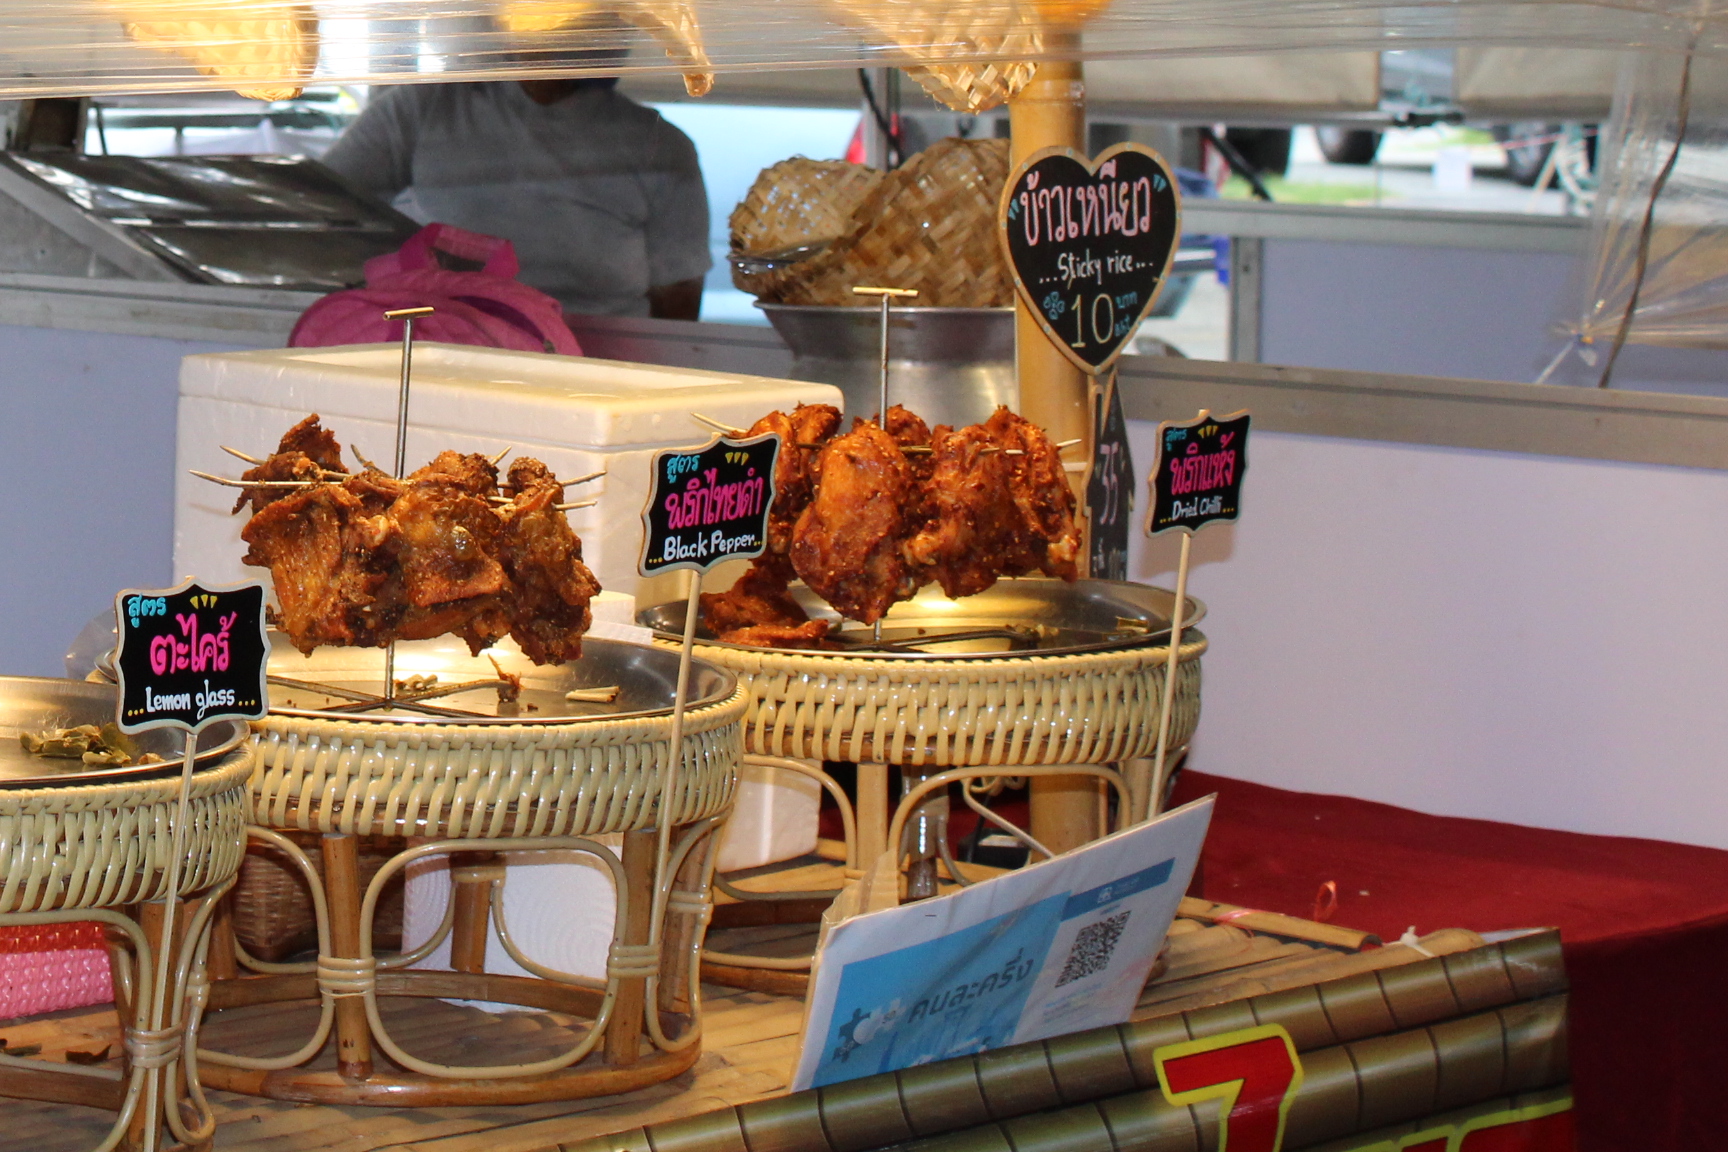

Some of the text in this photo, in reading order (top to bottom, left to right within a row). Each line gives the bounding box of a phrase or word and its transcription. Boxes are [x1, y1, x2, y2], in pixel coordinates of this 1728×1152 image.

[1019, 159, 1152, 247] ข้าวเหนียว
[1070, 292, 1115, 348] 10
[666, 453, 701, 485] สูตร
[1169, 431, 1238, 497] พริกแห้ง
[664, 466, 765, 531] พริกไทยดำ
[663, 531, 709, 562] Black
[127, 593, 167, 629] สูตร
[149, 611, 239, 677] ตะไคร้
[145, 685, 192, 714] Lemon
[905, 946, 1035, 1025] คนละครึ่ง
